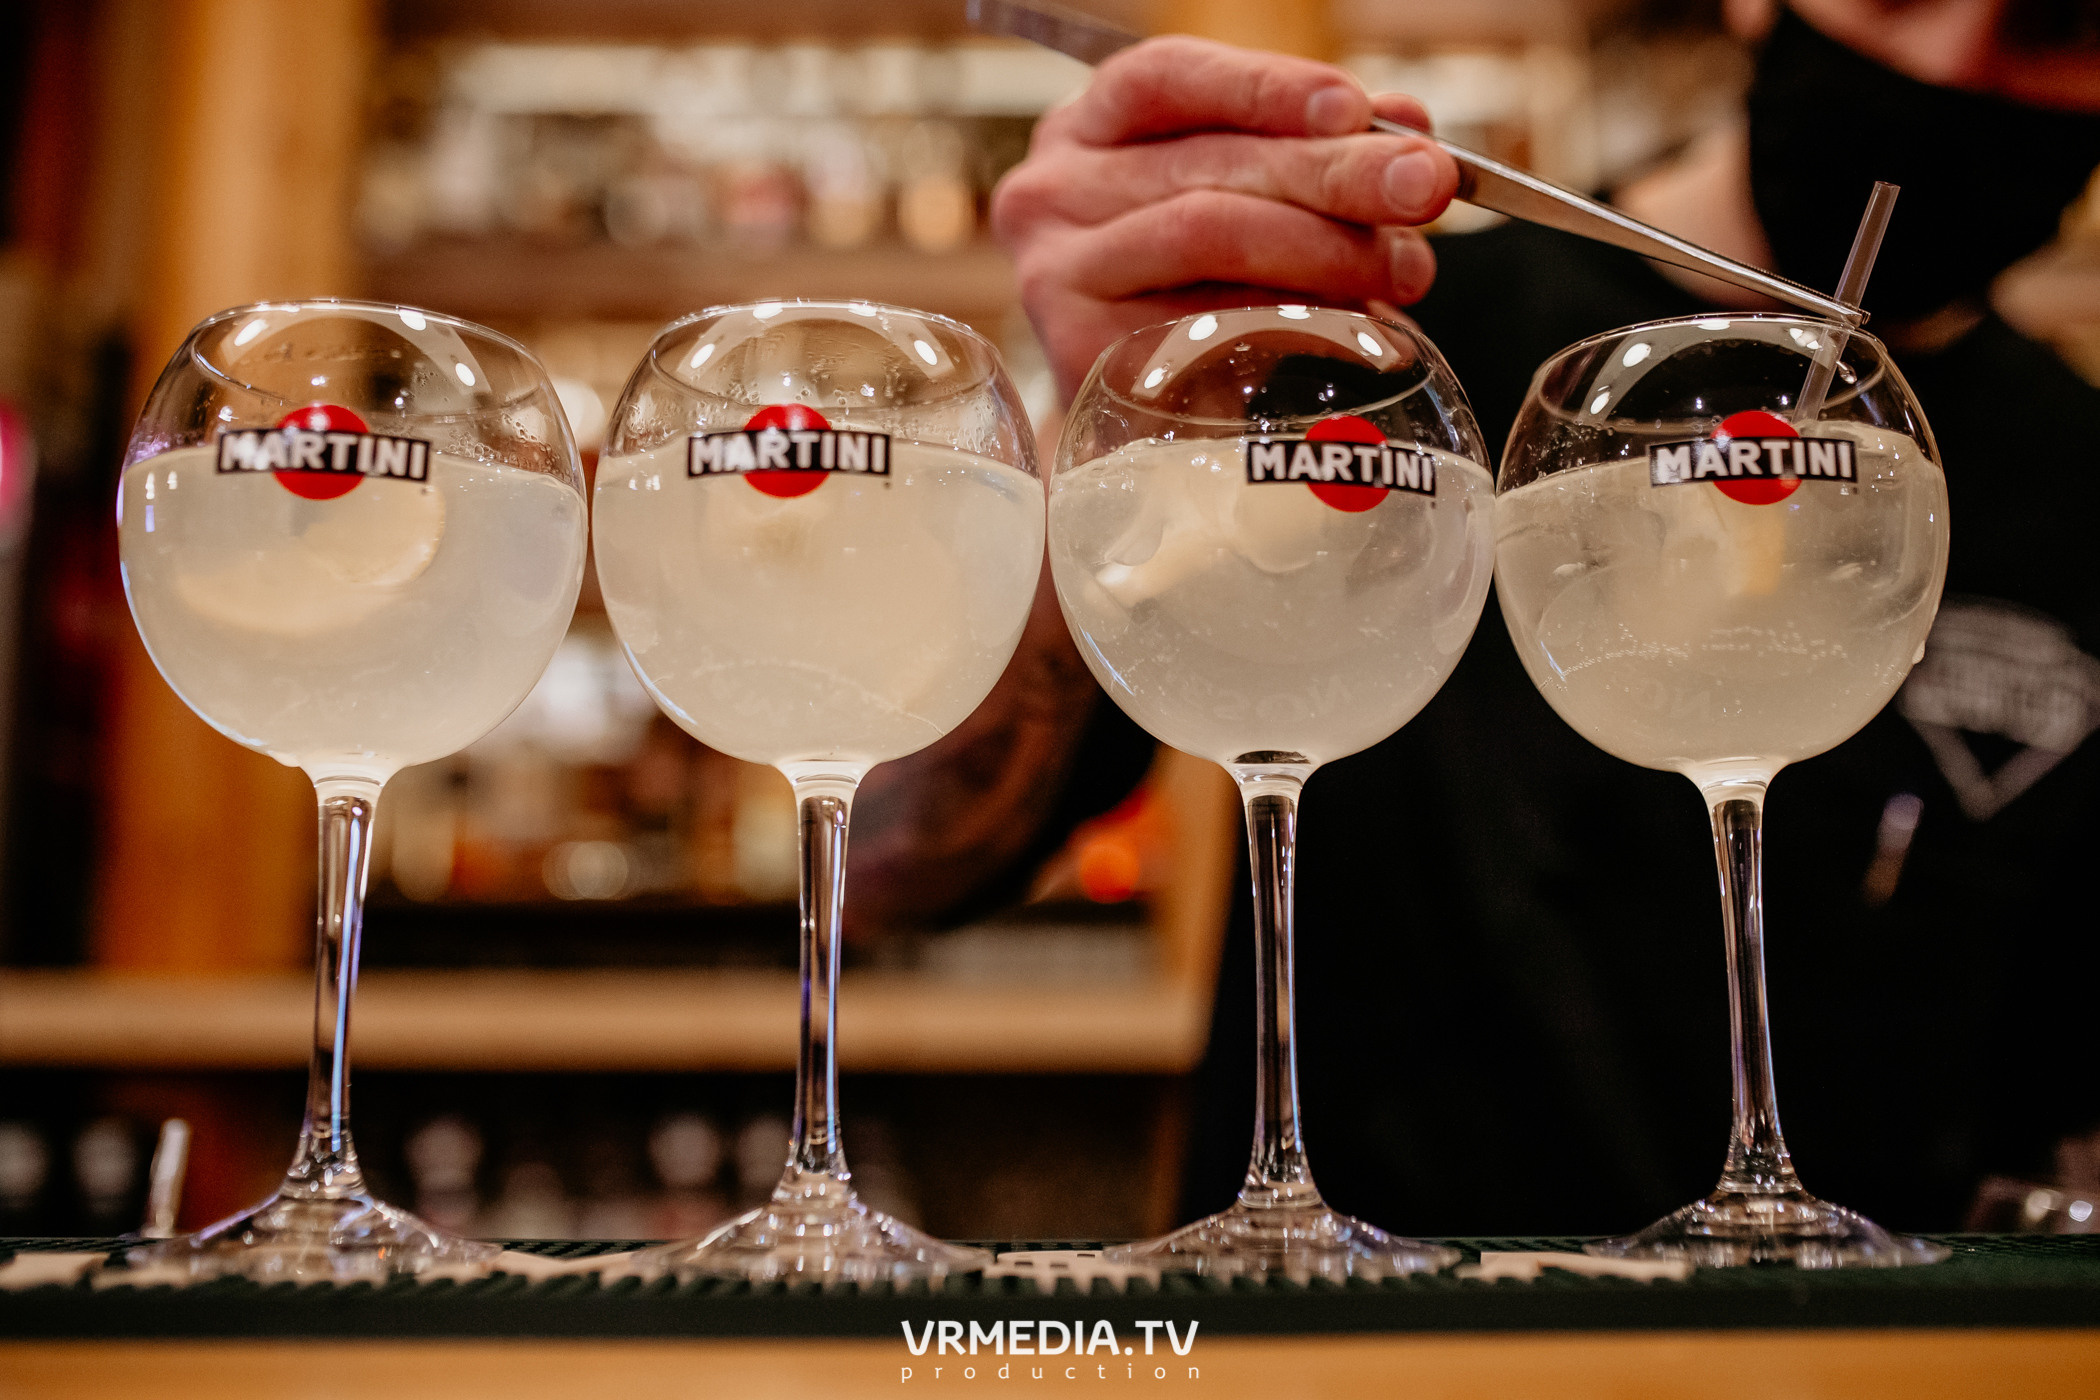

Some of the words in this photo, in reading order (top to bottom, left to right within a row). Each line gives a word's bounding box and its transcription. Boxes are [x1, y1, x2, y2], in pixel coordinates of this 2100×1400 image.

[220, 430, 426, 480] MARTINI
[689, 430, 887, 475] MARTINI
[1250, 442, 1434, 492] MARTINI
[1654, 439, 1852, 483] MARTINI
